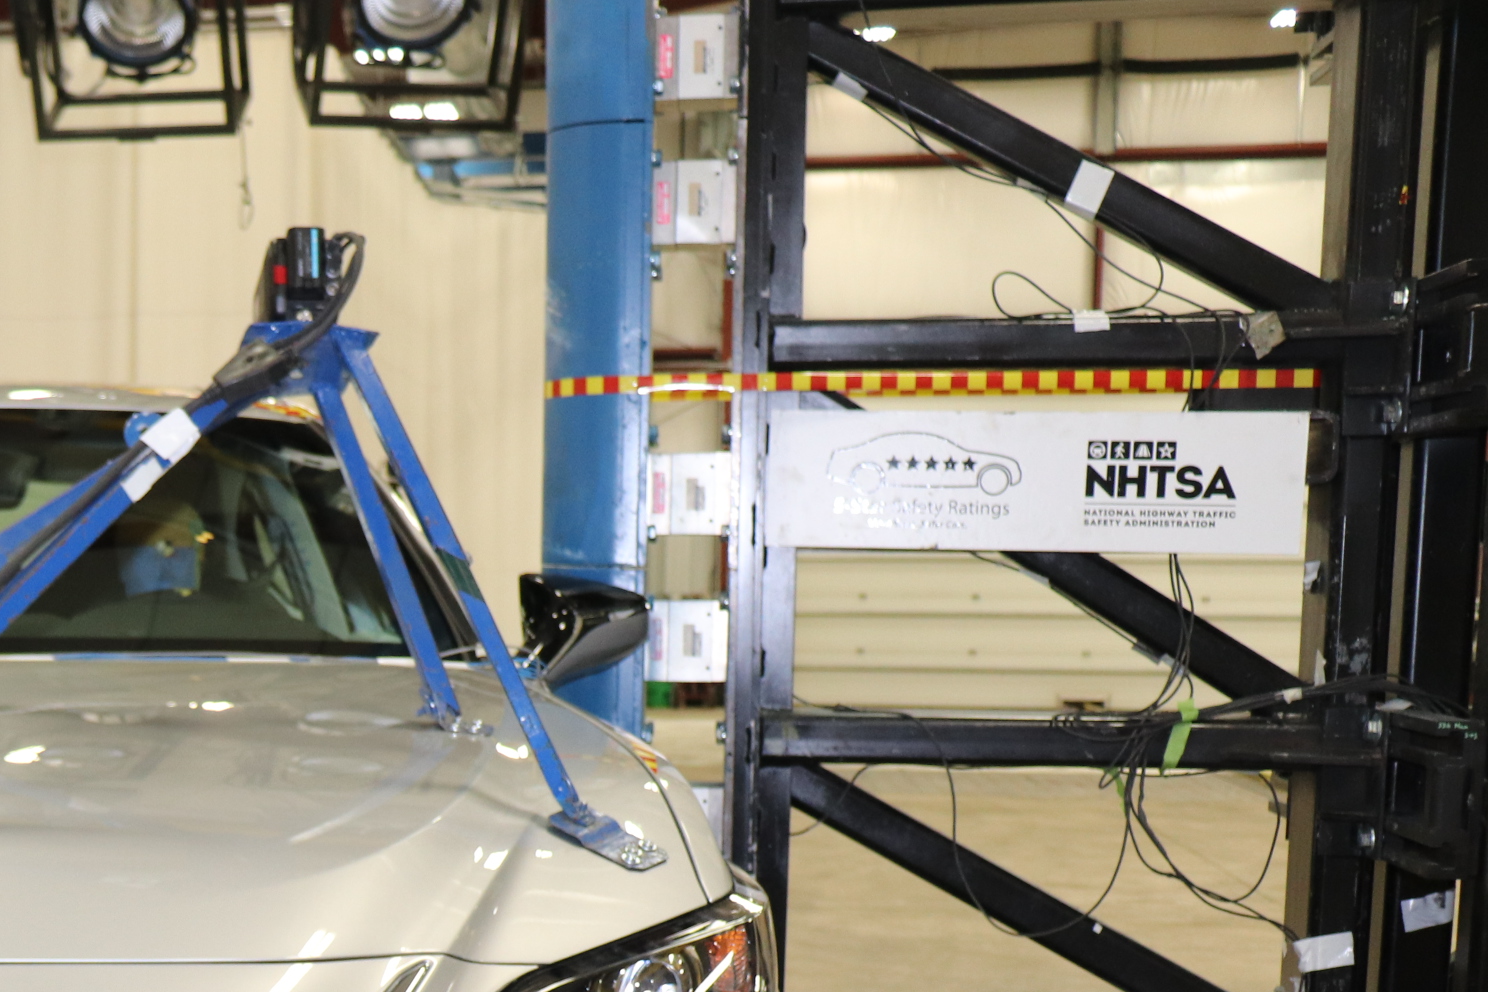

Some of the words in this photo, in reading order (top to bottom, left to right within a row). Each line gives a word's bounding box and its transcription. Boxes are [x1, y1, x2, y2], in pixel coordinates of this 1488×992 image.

[1085, 465, 1236, 499] NHTSA
[948, 499, 1010, 520] Ratings
[1084, 508, 1135, 518] NATIONAL
[1139, 509, 1189, 519] HIGHWAY
[1193, 510, 1237, 519] TRAFFIC
[1083, 518, 1121, 527] SAFETY
[1124, 518, 1216, 528] ADMINISTRATION
